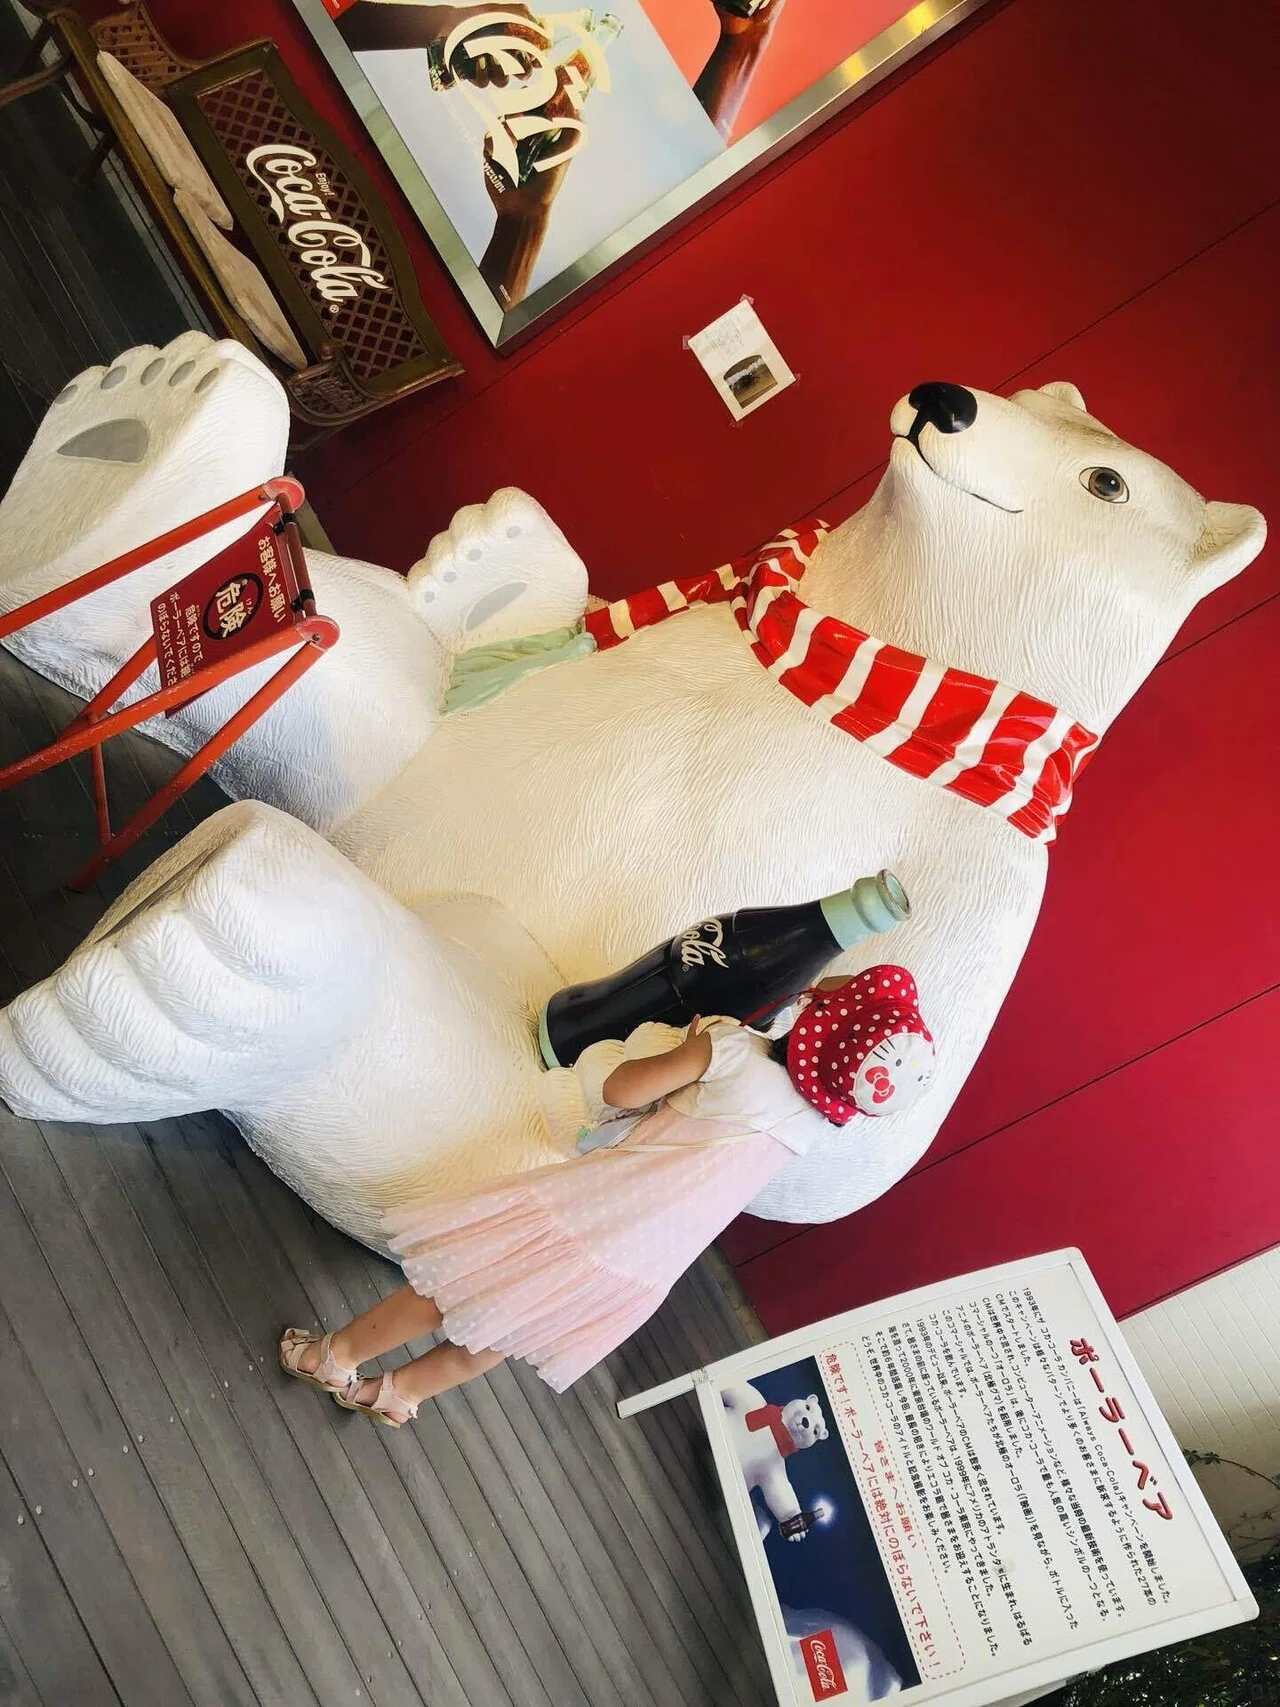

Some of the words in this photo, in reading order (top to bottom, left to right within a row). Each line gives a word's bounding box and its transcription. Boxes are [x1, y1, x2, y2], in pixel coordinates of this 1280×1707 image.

[246, 143, 393, 303] Coca-Cola
[314, 171, 335, 197] Enjoy!
[214, 581, 248, 637] 危険
[258, 536, 286, 622] お客様へお願い
[157, 602, 178, 687] のぼらないでくださ
[169, 591, 192, 679] ポーラーベアには絶
[184, 603, 203, 665] 危険ですので
[928, 1313, 968, 1398] コカ・コーラを飲んでいます。
[994, 1292, 1033, 1366] CMでスタートしました。
[1069, 1337, 1174, 1521] ポーラーベア
[872, 1439, 920, 1549] 皆さまへお願い
[901, 1321, 1034, 1646] さて、皆さまの前に座っているポーラーベアは、1999年にアメリカのアトランタに生まれ、はるばる
[810, 1640, 838, 1692] Coca-Cola
